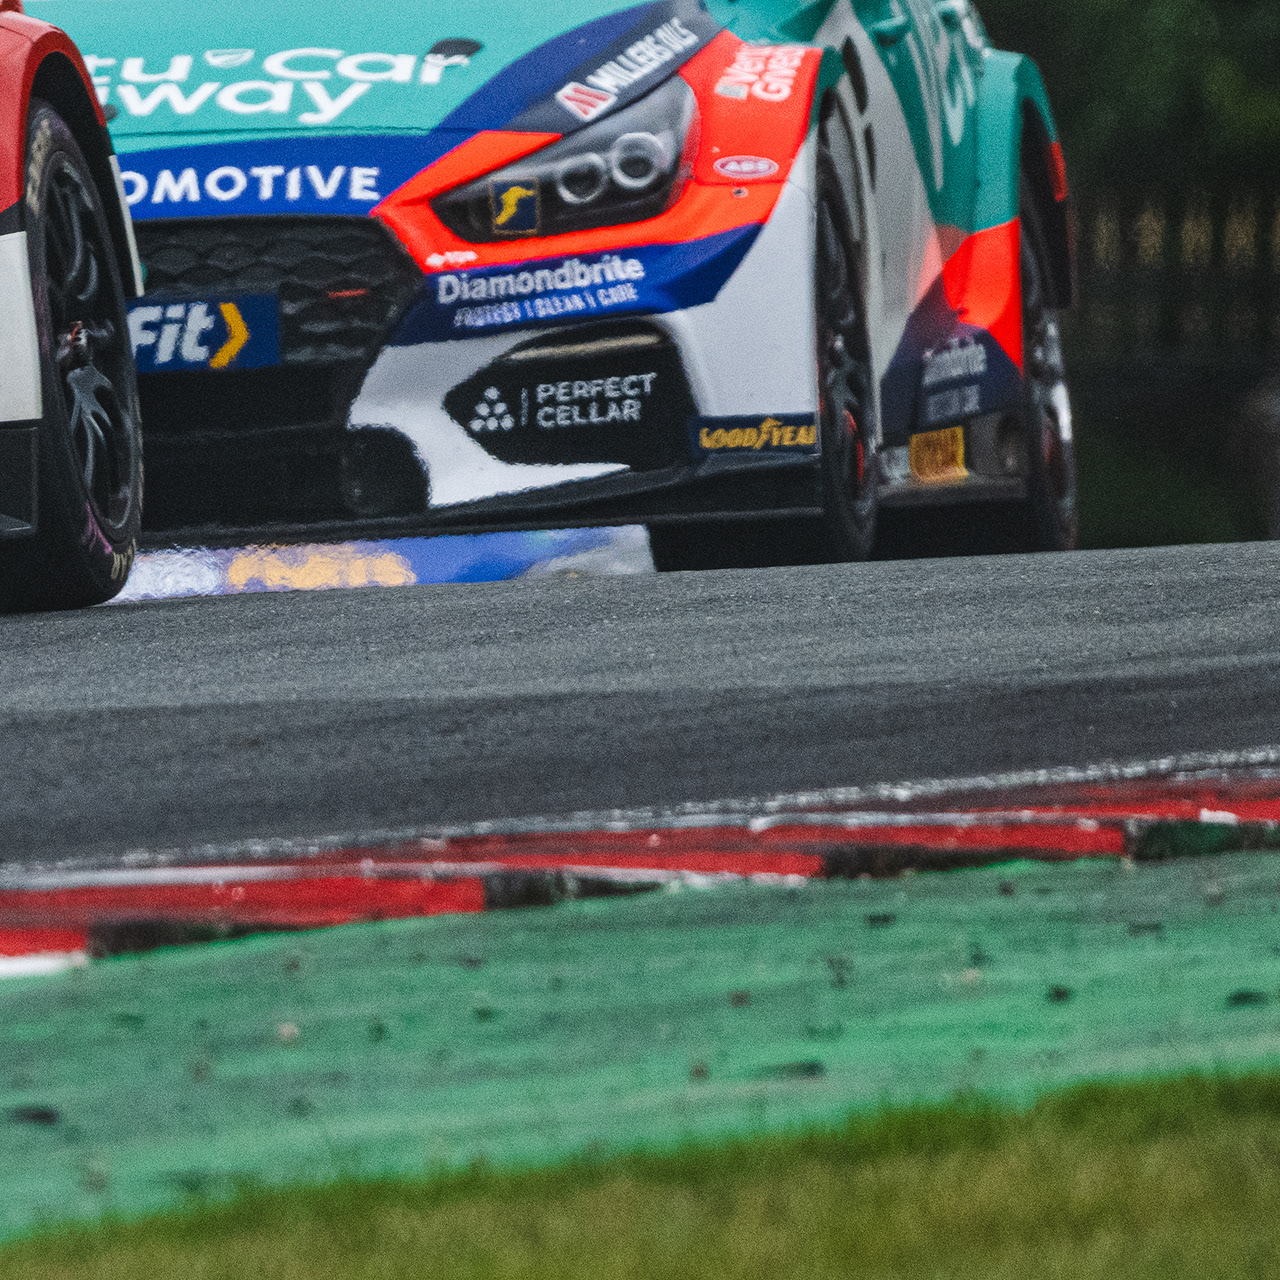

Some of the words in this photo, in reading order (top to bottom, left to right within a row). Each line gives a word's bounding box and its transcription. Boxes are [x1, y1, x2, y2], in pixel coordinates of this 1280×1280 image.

[84, 53, 194, 102] tu
[263, 47, 470, 86] Car
[586, 34, 675, 95] MILLERS
[96, 79, 373, 125] way
[120, 165, 381, 206] OMOTIVE
[438, 254, 645, 304] Diamondbrite
[127, 302, 214, 365] Fit
[536, 372, 658, 404] PERFECT
[536, 398, 643, 429] CELLAR
